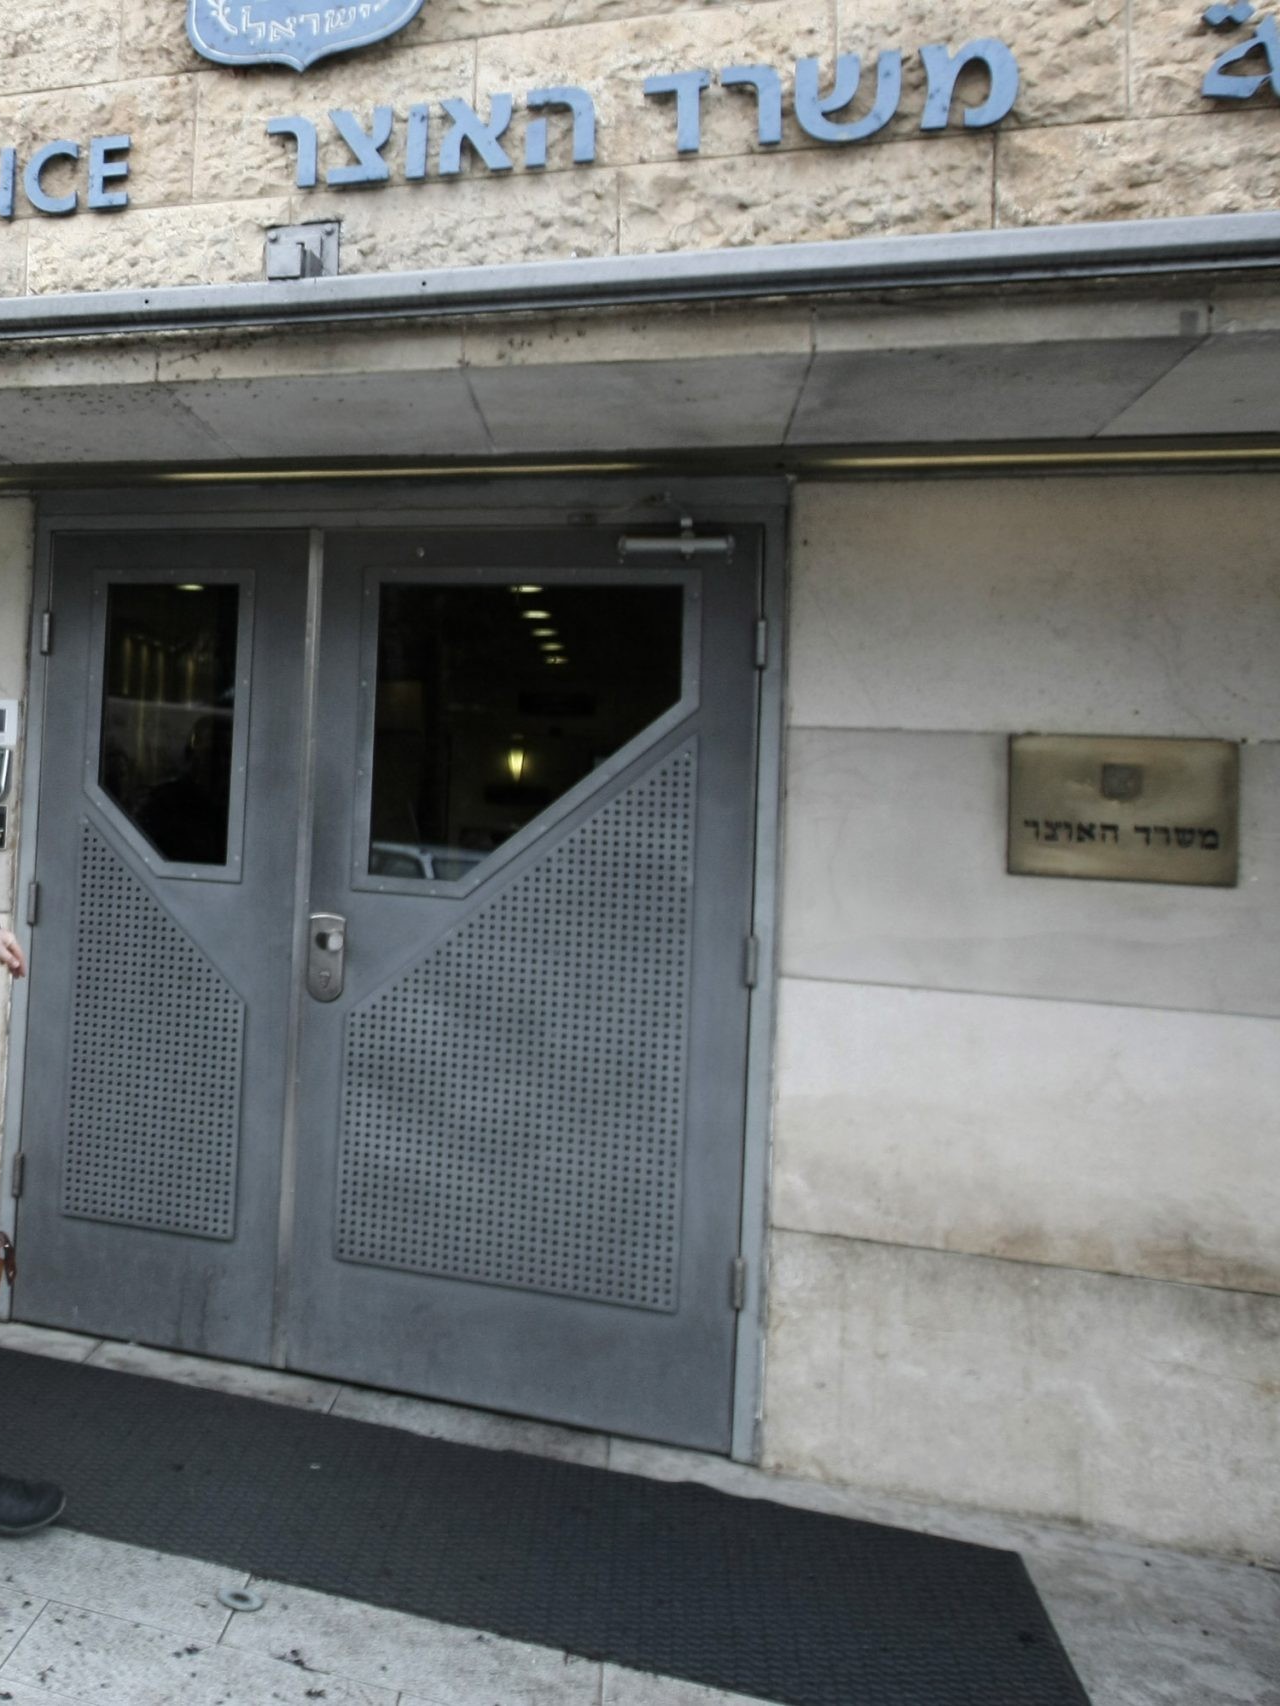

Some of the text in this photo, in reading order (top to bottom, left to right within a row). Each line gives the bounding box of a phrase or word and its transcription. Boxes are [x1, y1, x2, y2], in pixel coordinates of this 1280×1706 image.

[240, 3, 372, 44] ישראל
[266, 38, 1019, 189] משרד האוצר
[1023, 818, 1220, 850] משרד האוצר
